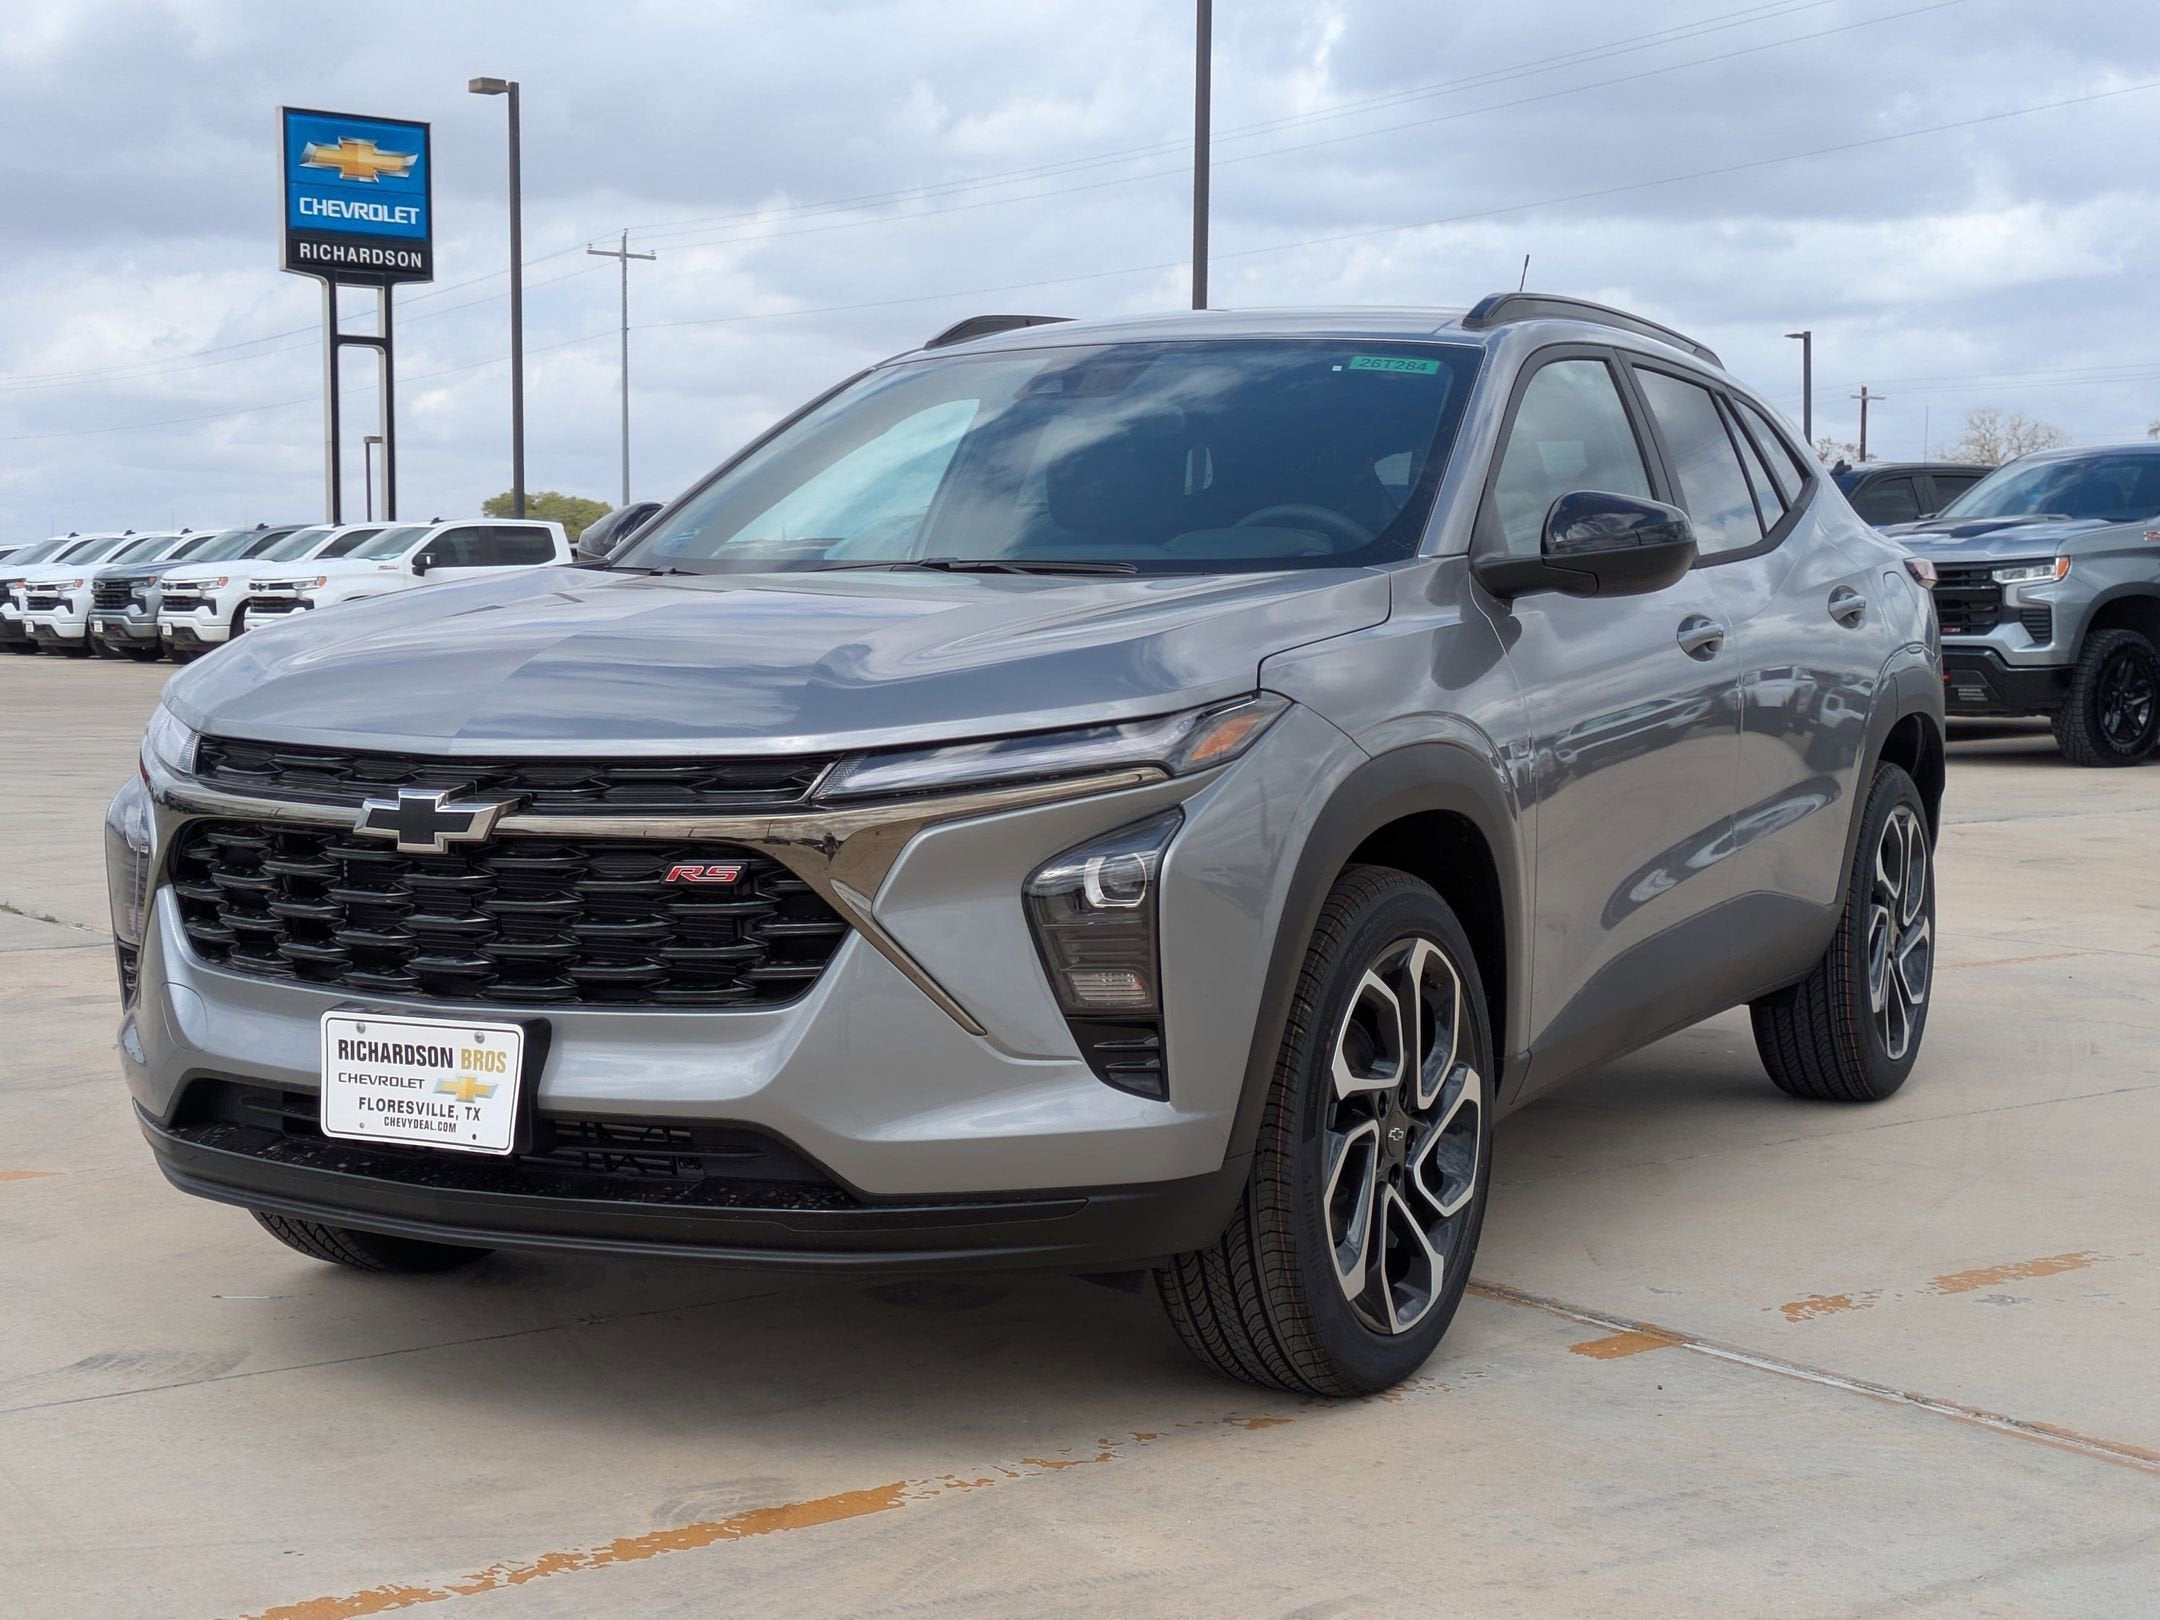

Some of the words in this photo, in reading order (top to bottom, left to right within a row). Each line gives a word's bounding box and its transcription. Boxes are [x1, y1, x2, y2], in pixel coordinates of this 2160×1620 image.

[299, 197, 420, 225] CHEVROLET
[299, 242, 422, 268] RICHARDSON
[1359, 358, 1428, 372] 26T284
[664, 865, 742, 882] RS
[338, 1039, 453, 1069] RICHARDSON
[460, 1048, 507, 1073] BROS
[338, 1072, 425, 1089] CHEVROLET
[358, 1096, 459, 1121] FLORESVILLE,
[465, 1106, 481, 1121] TX
[384, 1116, 457, 1133] CHEVYDEAL.COM
